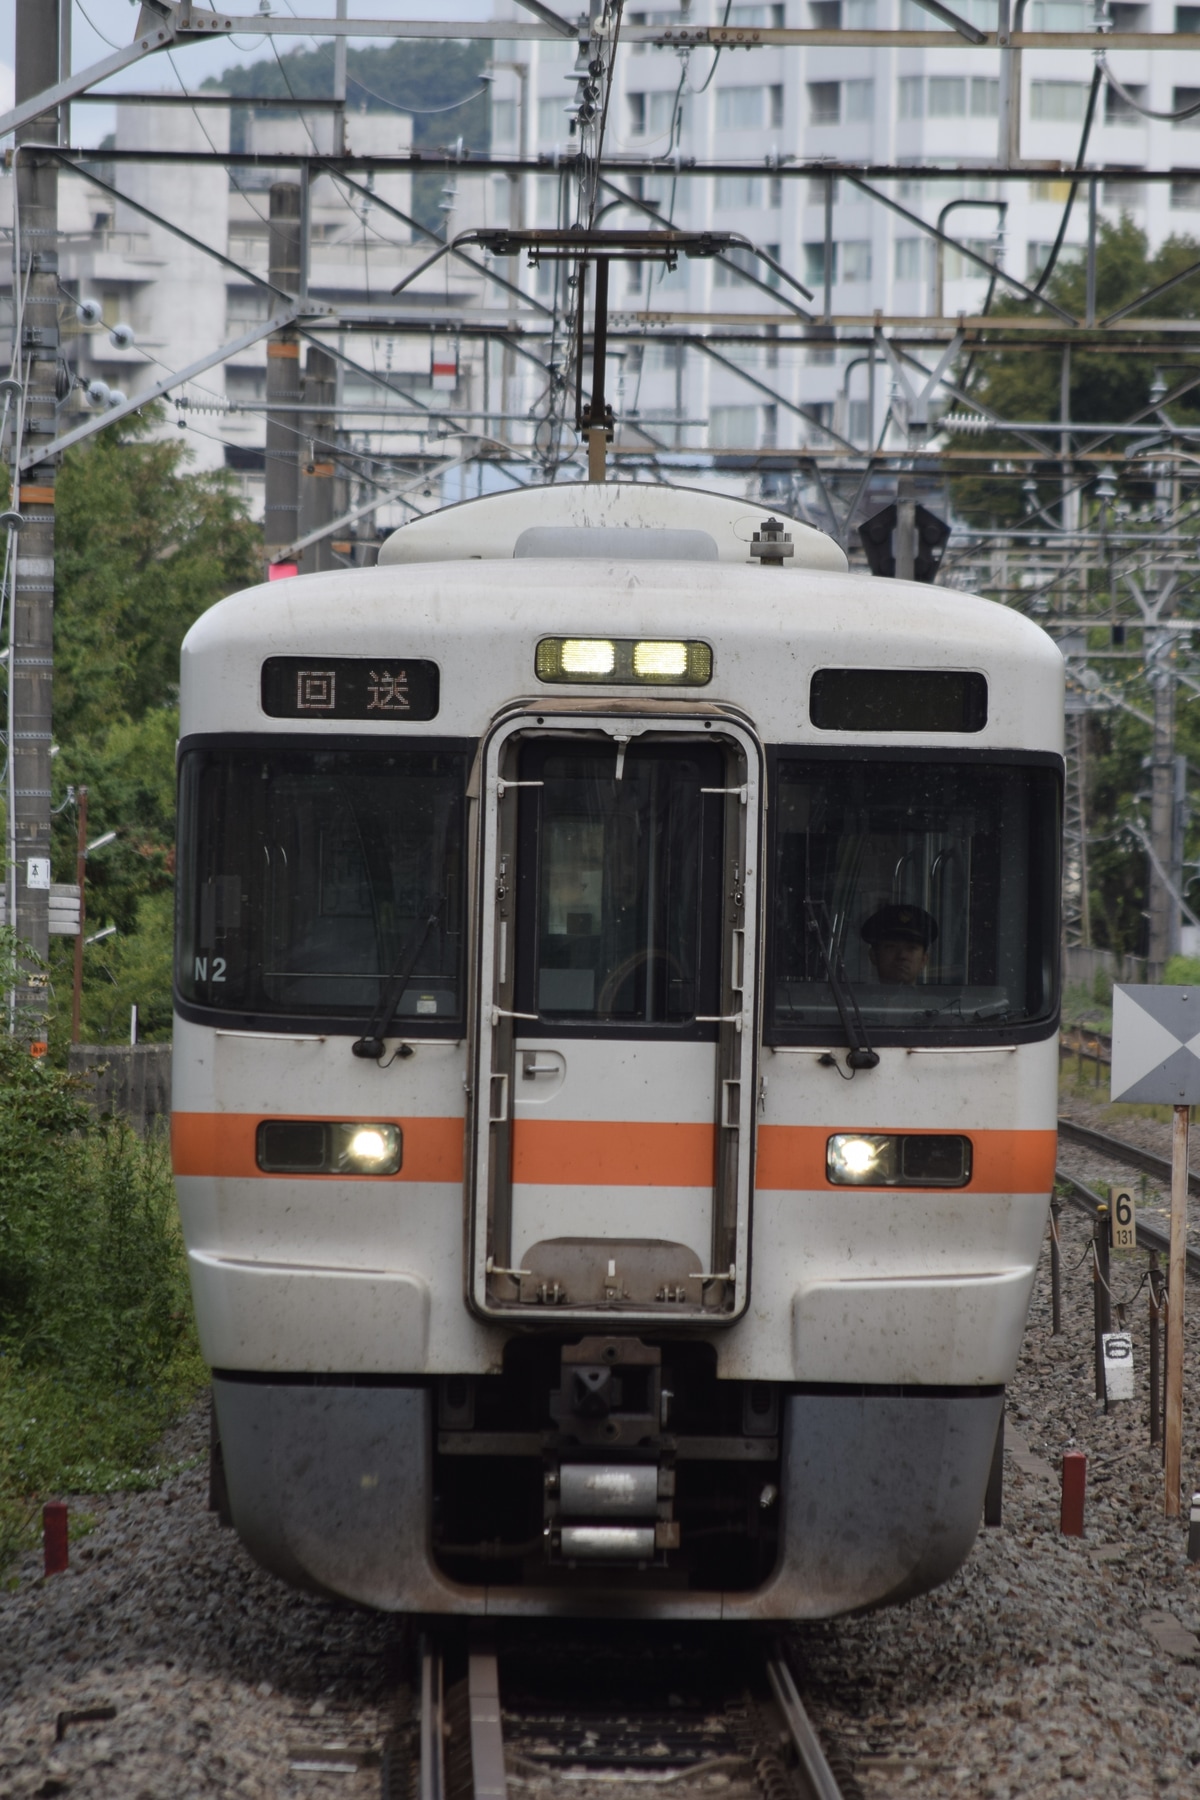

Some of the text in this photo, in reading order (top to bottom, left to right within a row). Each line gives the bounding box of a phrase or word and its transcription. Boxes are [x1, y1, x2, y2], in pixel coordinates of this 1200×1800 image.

[297, 670, 411, 710] 回送
[1116, 1193, 1132, 1226] 6
[1116, 1230, 1133, 1245] 131
[1105, 1338, 1130, 1360] 6
